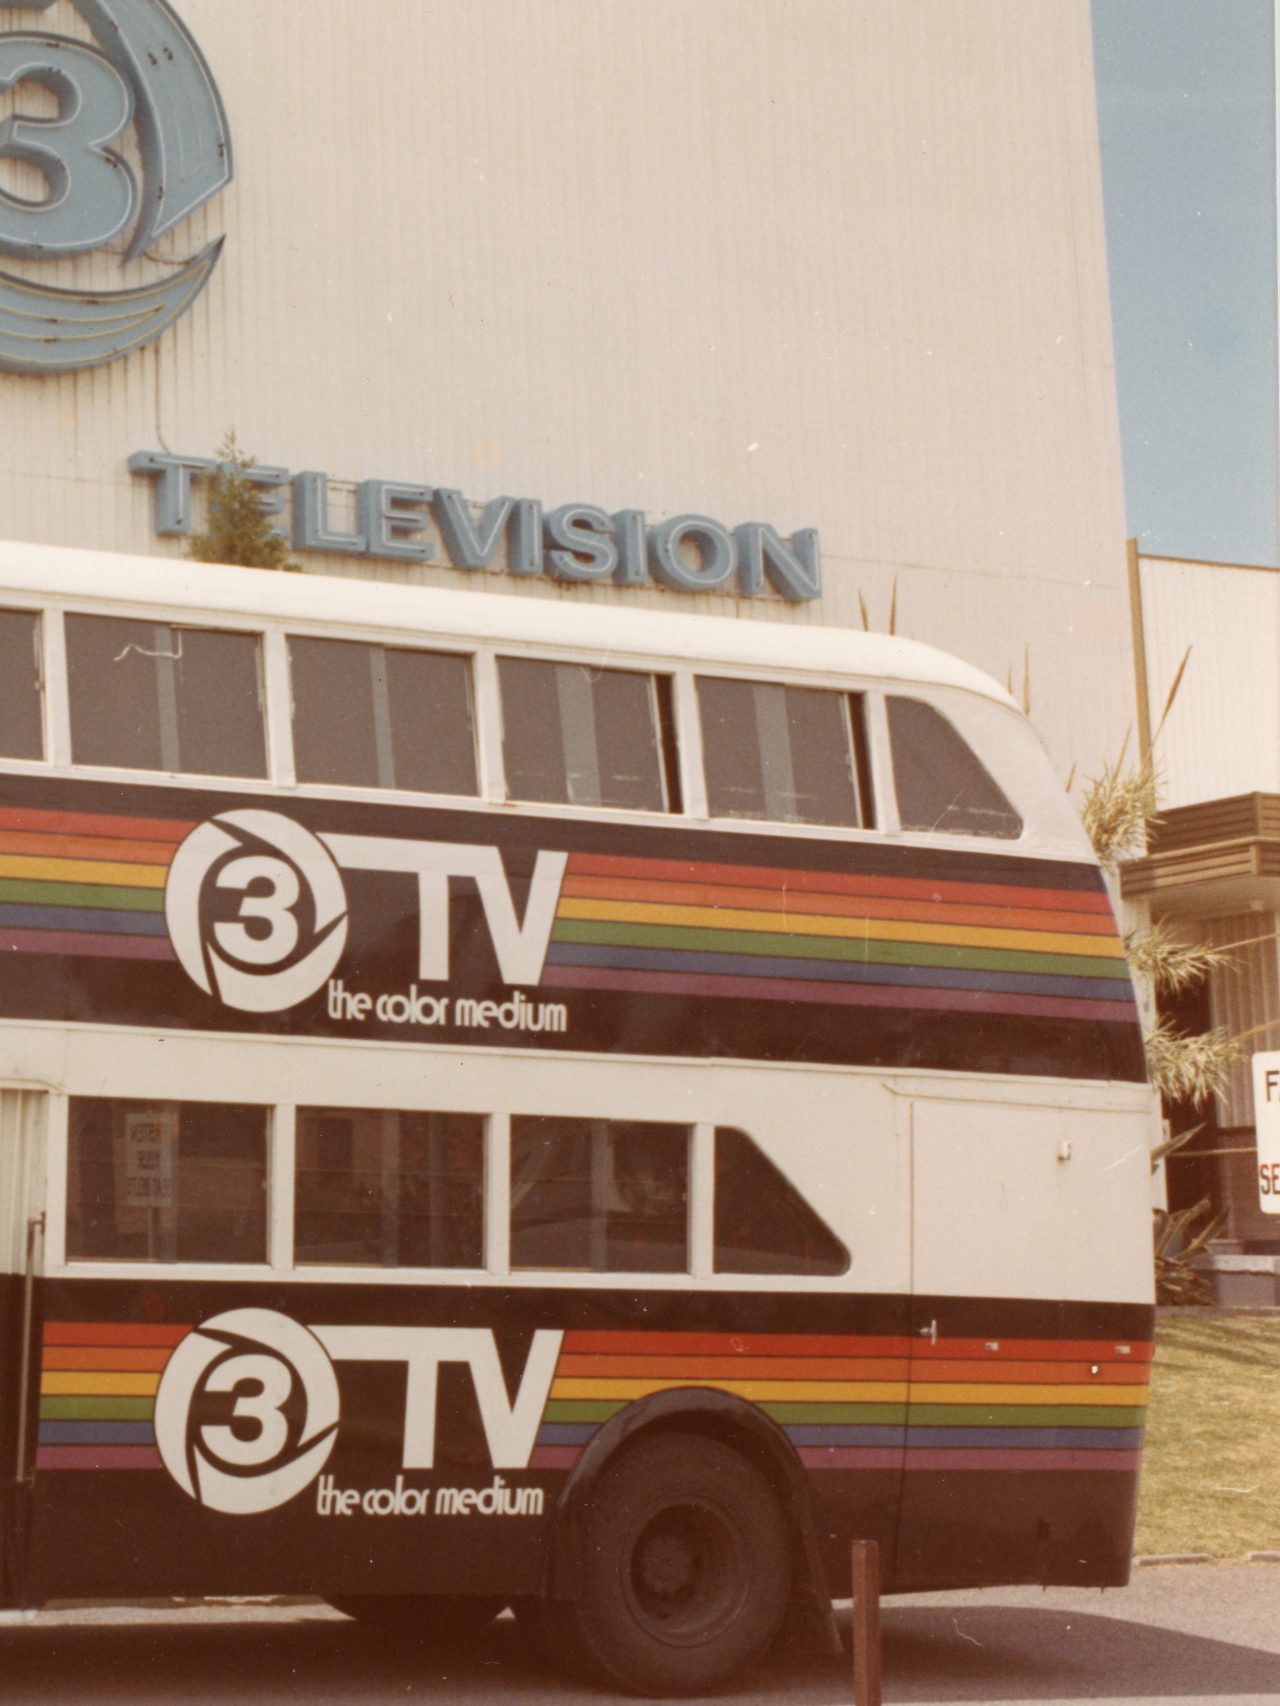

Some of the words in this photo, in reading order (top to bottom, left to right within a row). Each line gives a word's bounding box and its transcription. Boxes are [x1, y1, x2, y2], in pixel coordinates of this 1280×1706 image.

[213, 855, 300, 965] 3
[316, 832, 569, 986] TV
[327, 979, 372, 1021] the
[375, 984, 450, 1026] color
[454, 991, 568, 1032] medium
[200, 1354, 292, 1466] 3
[306, 1325, 565, 1469] TV
[316, 1474, 360, 1516] the
[362, 1475, 430, 1516] color
[434, 1475, 544, 1516] medium
